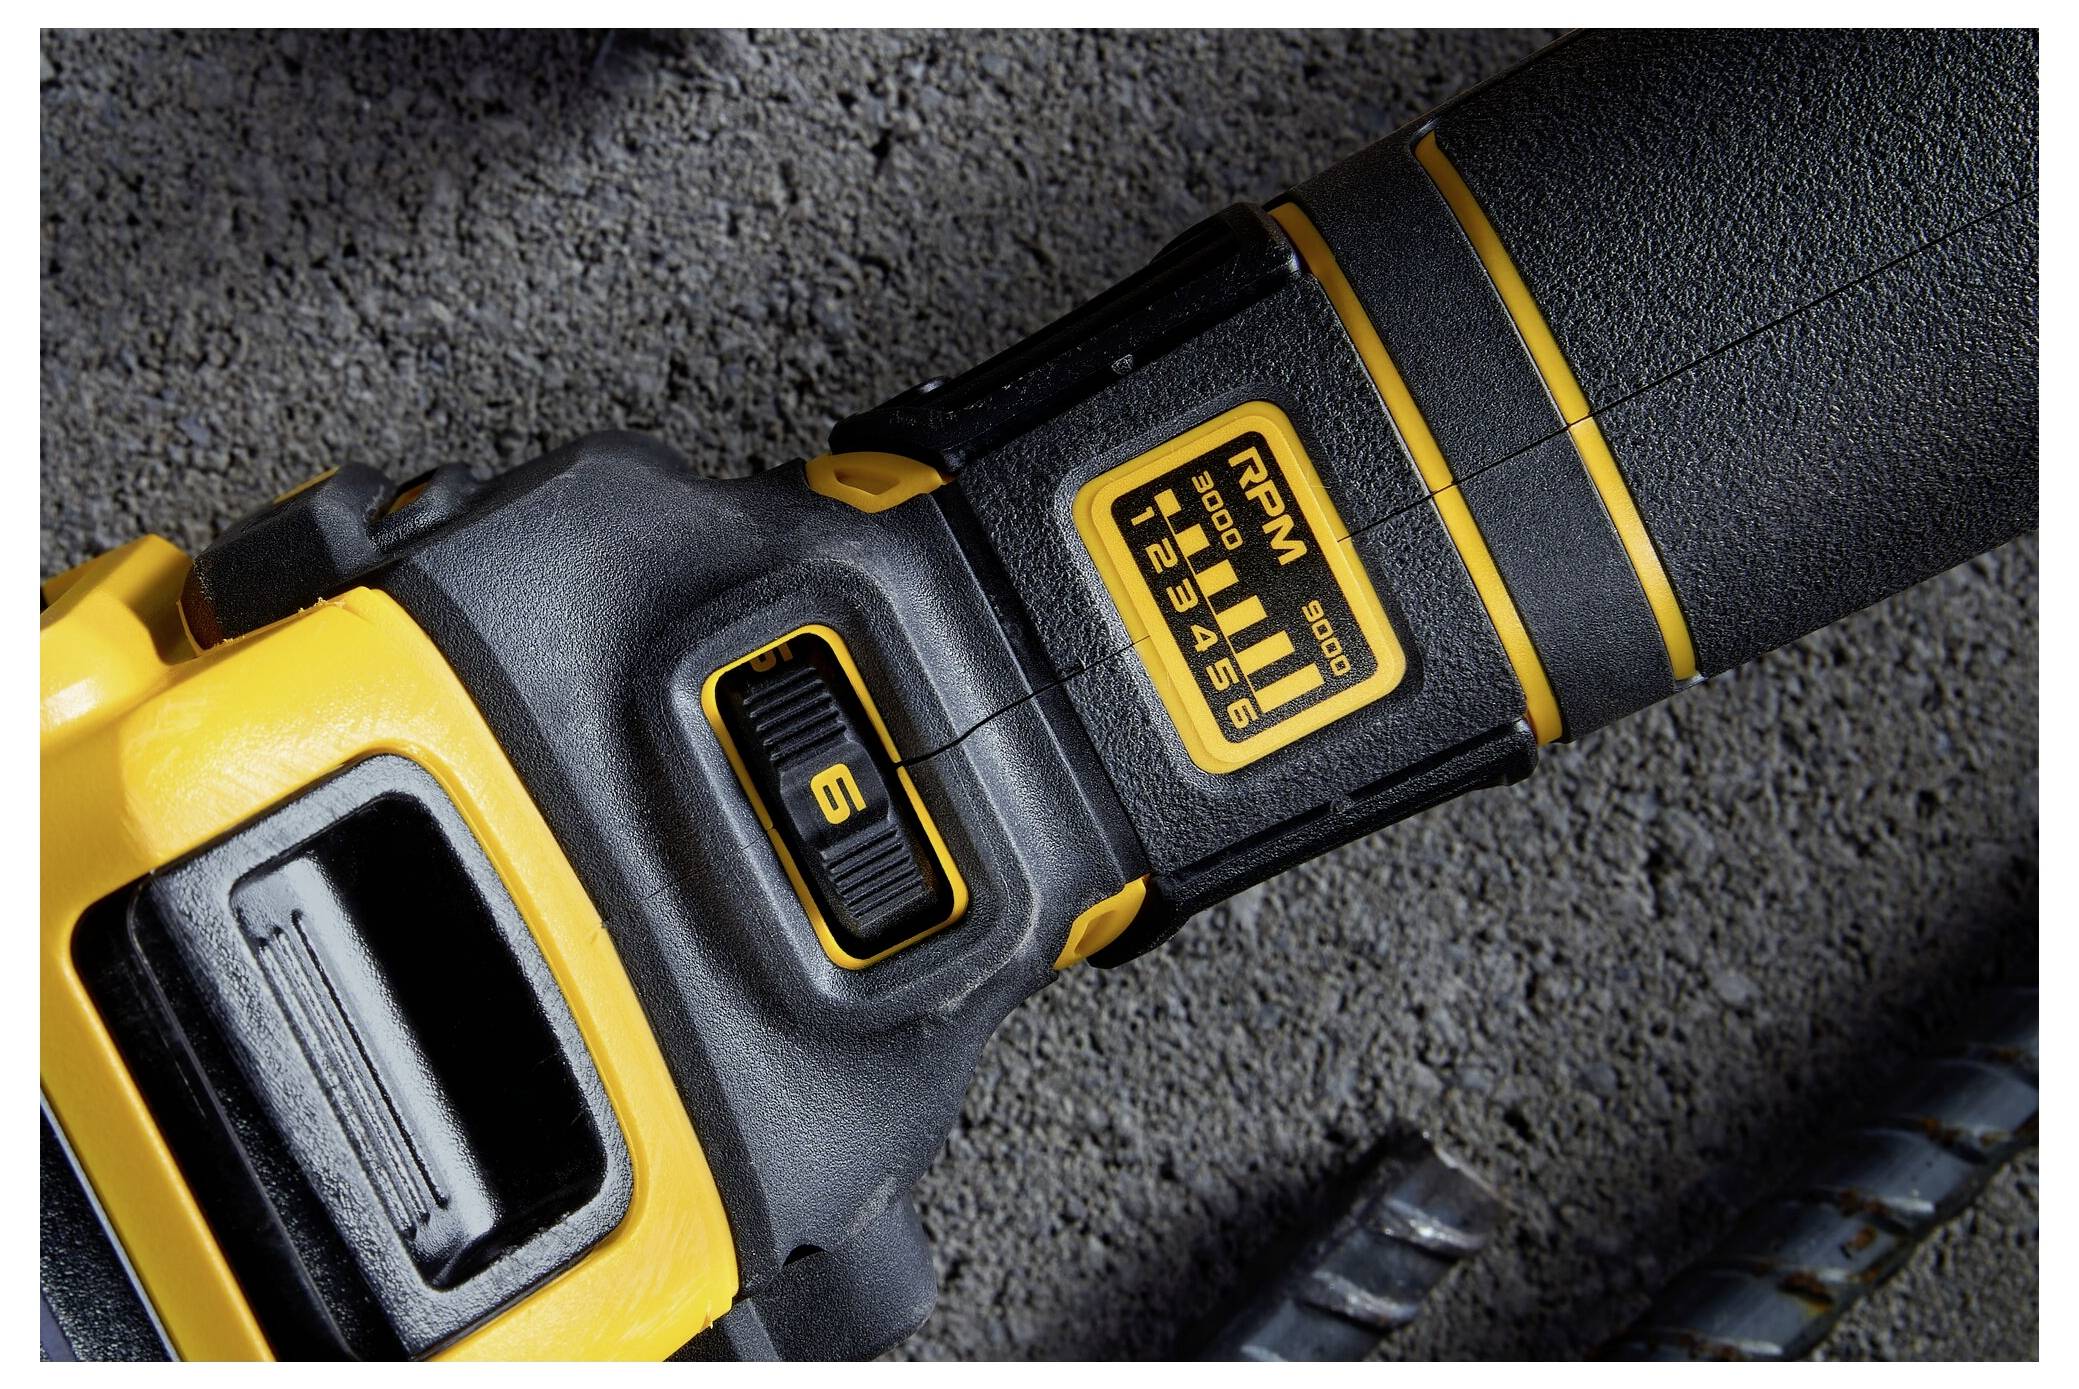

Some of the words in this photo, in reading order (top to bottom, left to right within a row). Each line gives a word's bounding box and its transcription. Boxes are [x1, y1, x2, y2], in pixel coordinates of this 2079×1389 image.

[1191, 470, 1244, 551] 3000
[1228, 447, 1308, 566] RPM
[1131, 505, 1155, 526] 1
[1144, 538, 1179, 574] 2
[1166, 578, 1199, 613] 3
[1190, 624, 1218, 653] 4
[1205, 657, 1240, 692] 5
[1226, 697, 1259, 730] 6
[1301, 599, 1351, 677] 9000
[809, 762, 867, 825] 6
